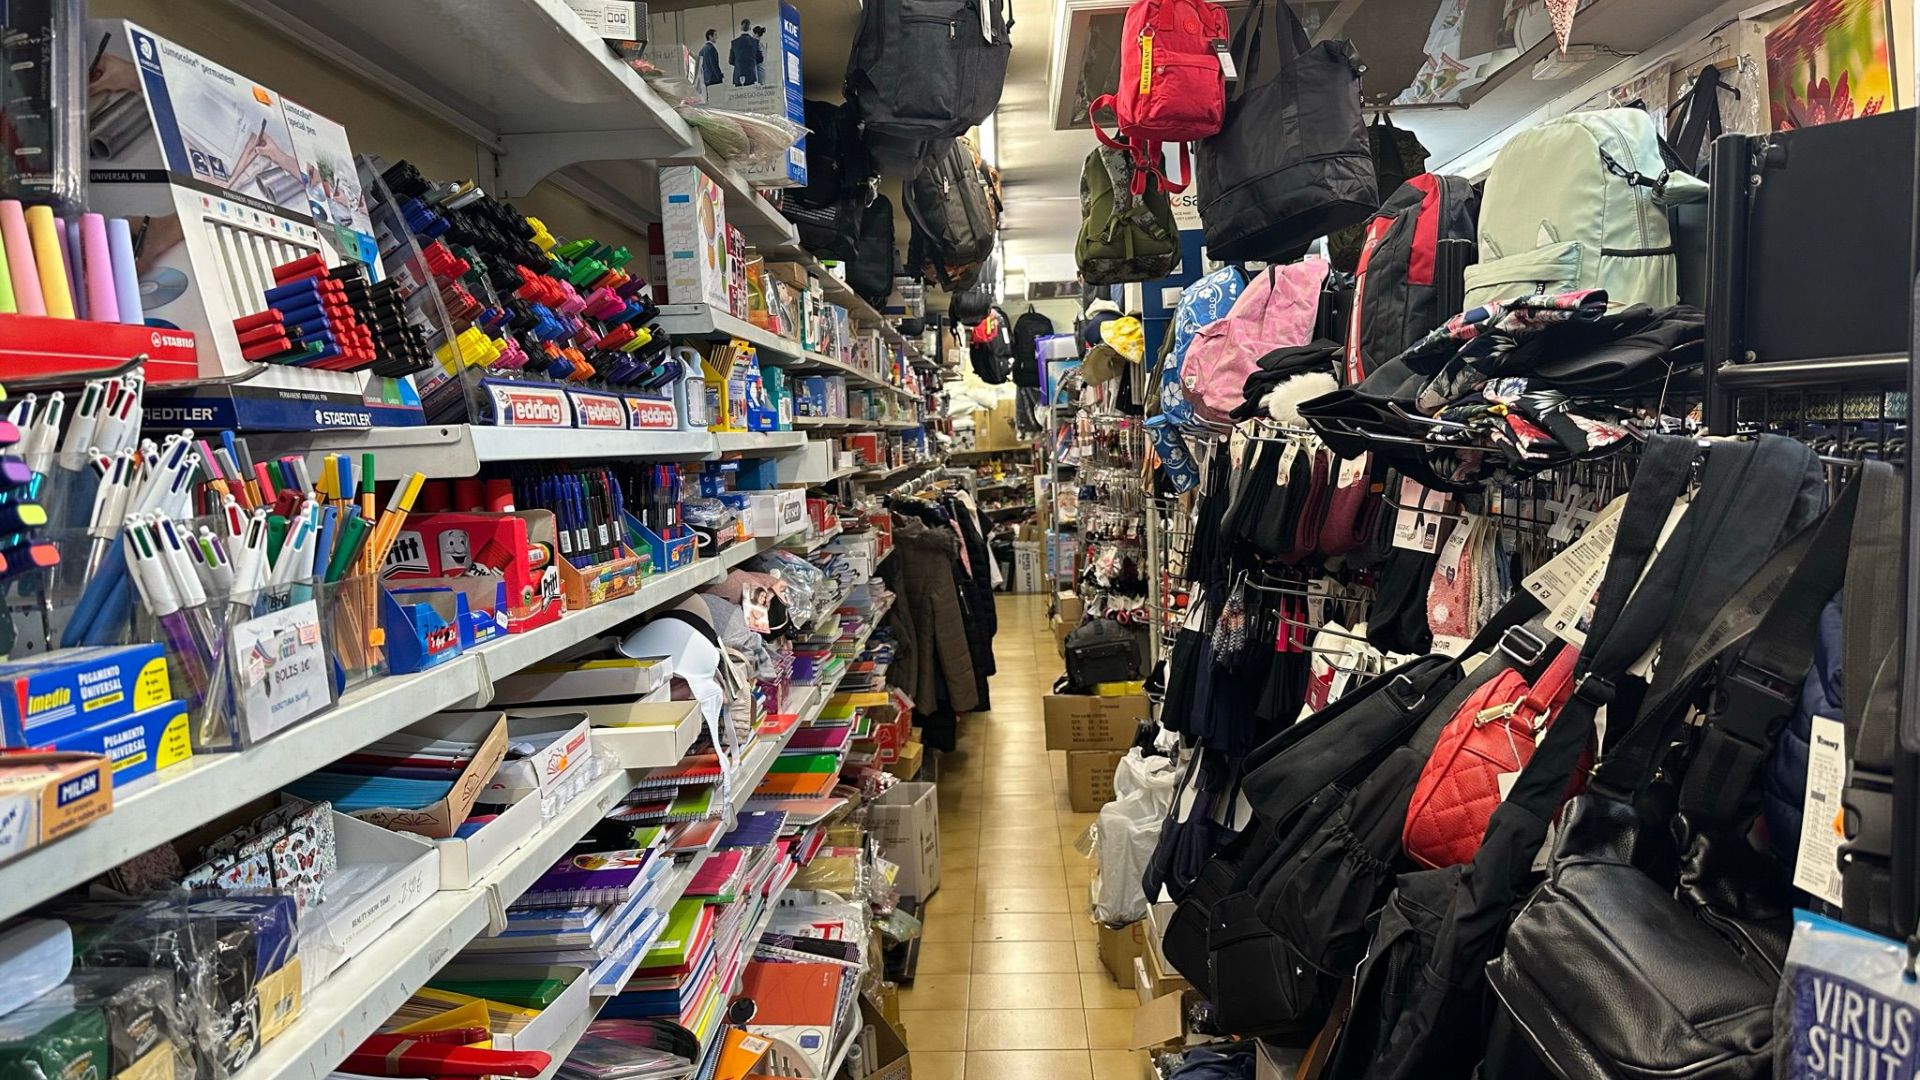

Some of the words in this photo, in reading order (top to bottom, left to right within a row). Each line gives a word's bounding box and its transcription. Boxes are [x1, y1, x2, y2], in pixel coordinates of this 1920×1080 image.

[784, 19, 798, 37] KDE
[201, 65, 236, 86] permanent
[90, 173, 130, 182] UNIVERSAL
[131, 173, 146, 182] PEN
[162, 335, 195, 349] STABILO
[279, 391, 302, 400] PERMANENT
[320, 393, 328, 402] PEN
[515, 402, 561, 424] edding
[588, 403, 621, 426] edding
[640, 407, 673, 426] edding
[386, 536, 419, 564] ritt
[543, 573, 559, 598] Pritt
[78, 665, 121, 686] PEGAMENTO
[275, 664, 299, 684] BOLIS
[301, 659, 311, 674] 1€
[80, 678, 123, 700] UNIVERSAL
[28, 687, 71, 716] Imedio
[103, 726, 145, 749] PEGAMENTO
[62, 774, 97, 804] MILAN
[1813, 976, 1913, 1057] VIRUS
